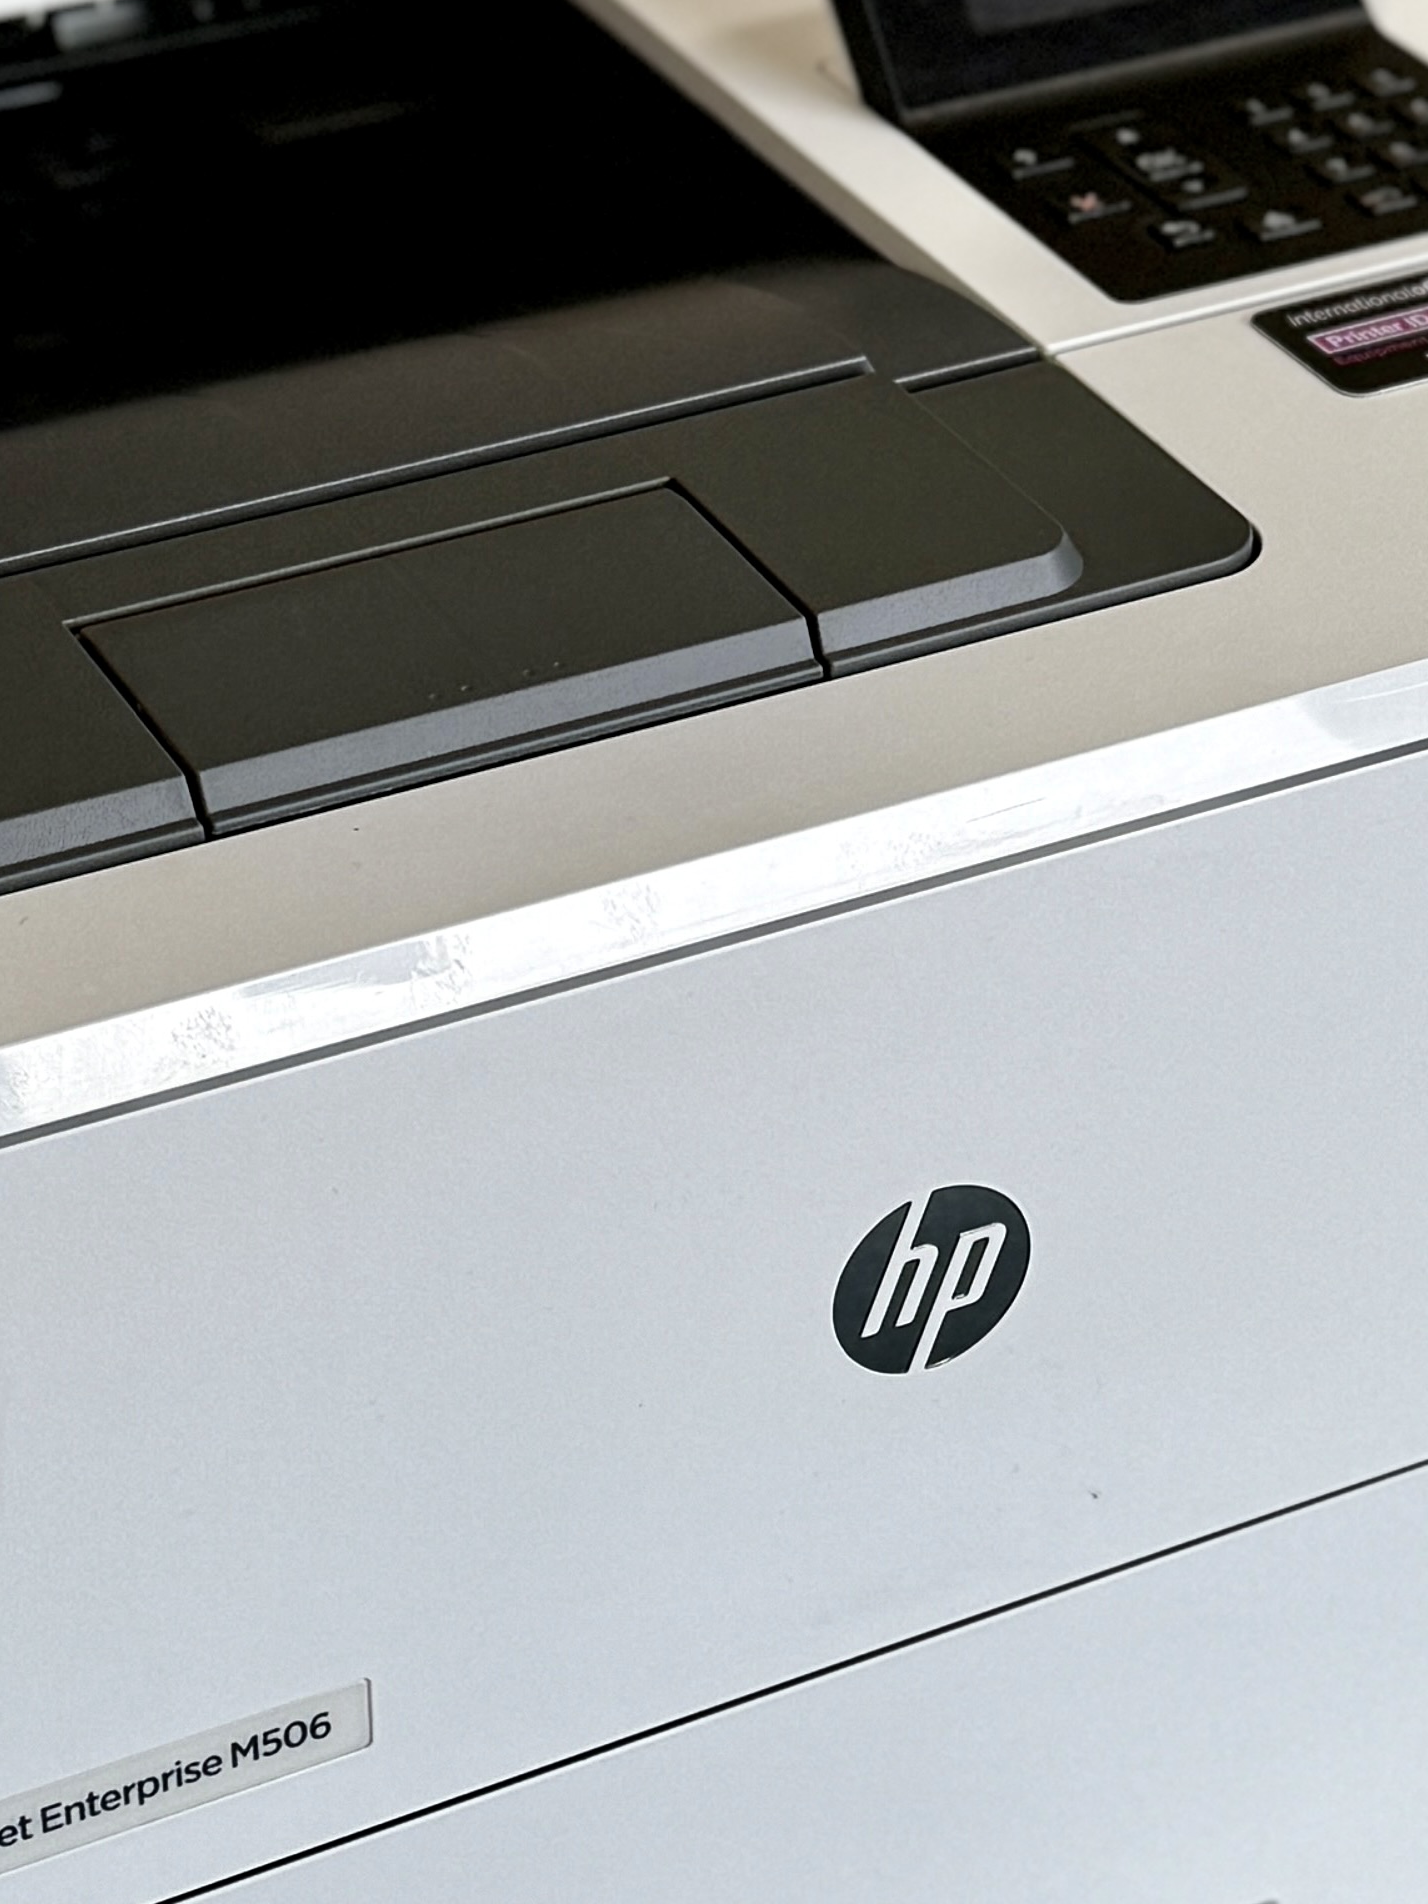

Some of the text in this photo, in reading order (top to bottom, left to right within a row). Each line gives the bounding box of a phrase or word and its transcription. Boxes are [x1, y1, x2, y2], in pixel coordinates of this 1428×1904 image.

[1324, 322, 1405, 347] Printer
[858, 1185, 1010, 1373] hp
[40, 1751, 224, 1834] Enterprise
[228, 1711, 333, 1769] M506
